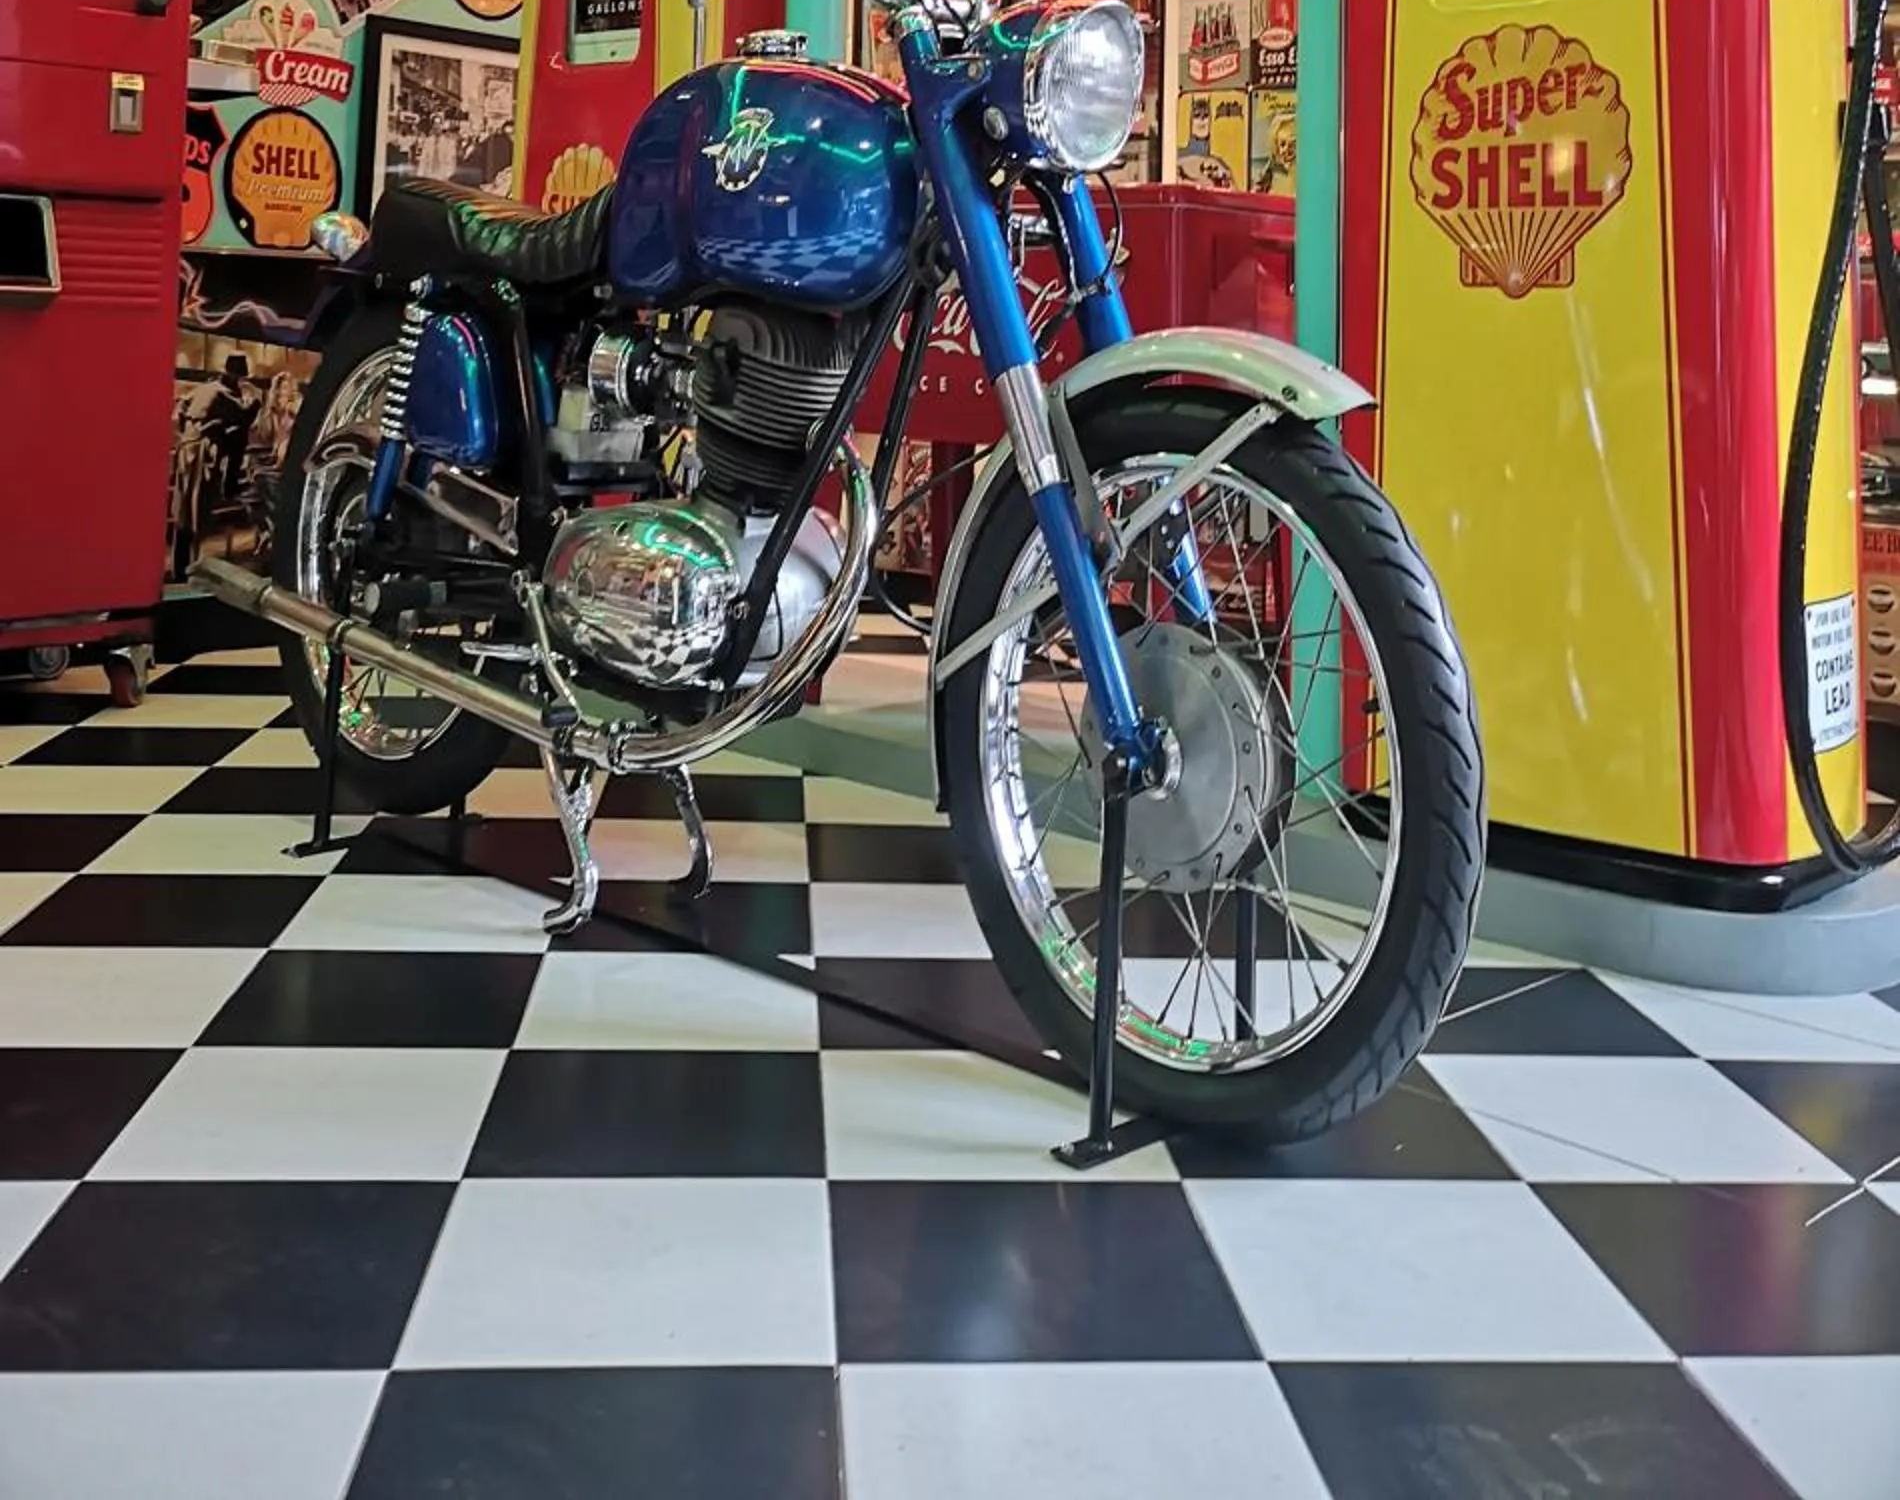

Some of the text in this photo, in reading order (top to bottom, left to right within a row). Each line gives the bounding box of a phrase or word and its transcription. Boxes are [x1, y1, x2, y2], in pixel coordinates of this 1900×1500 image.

[587, 0, 644, 15] GALLONS
[264, 51, 350, 94] Cream
[1435, 62, 1604, 141] Super
[251, 141, 320, 181] SHELL
[1431, 140, 1603, 210] SHELL
